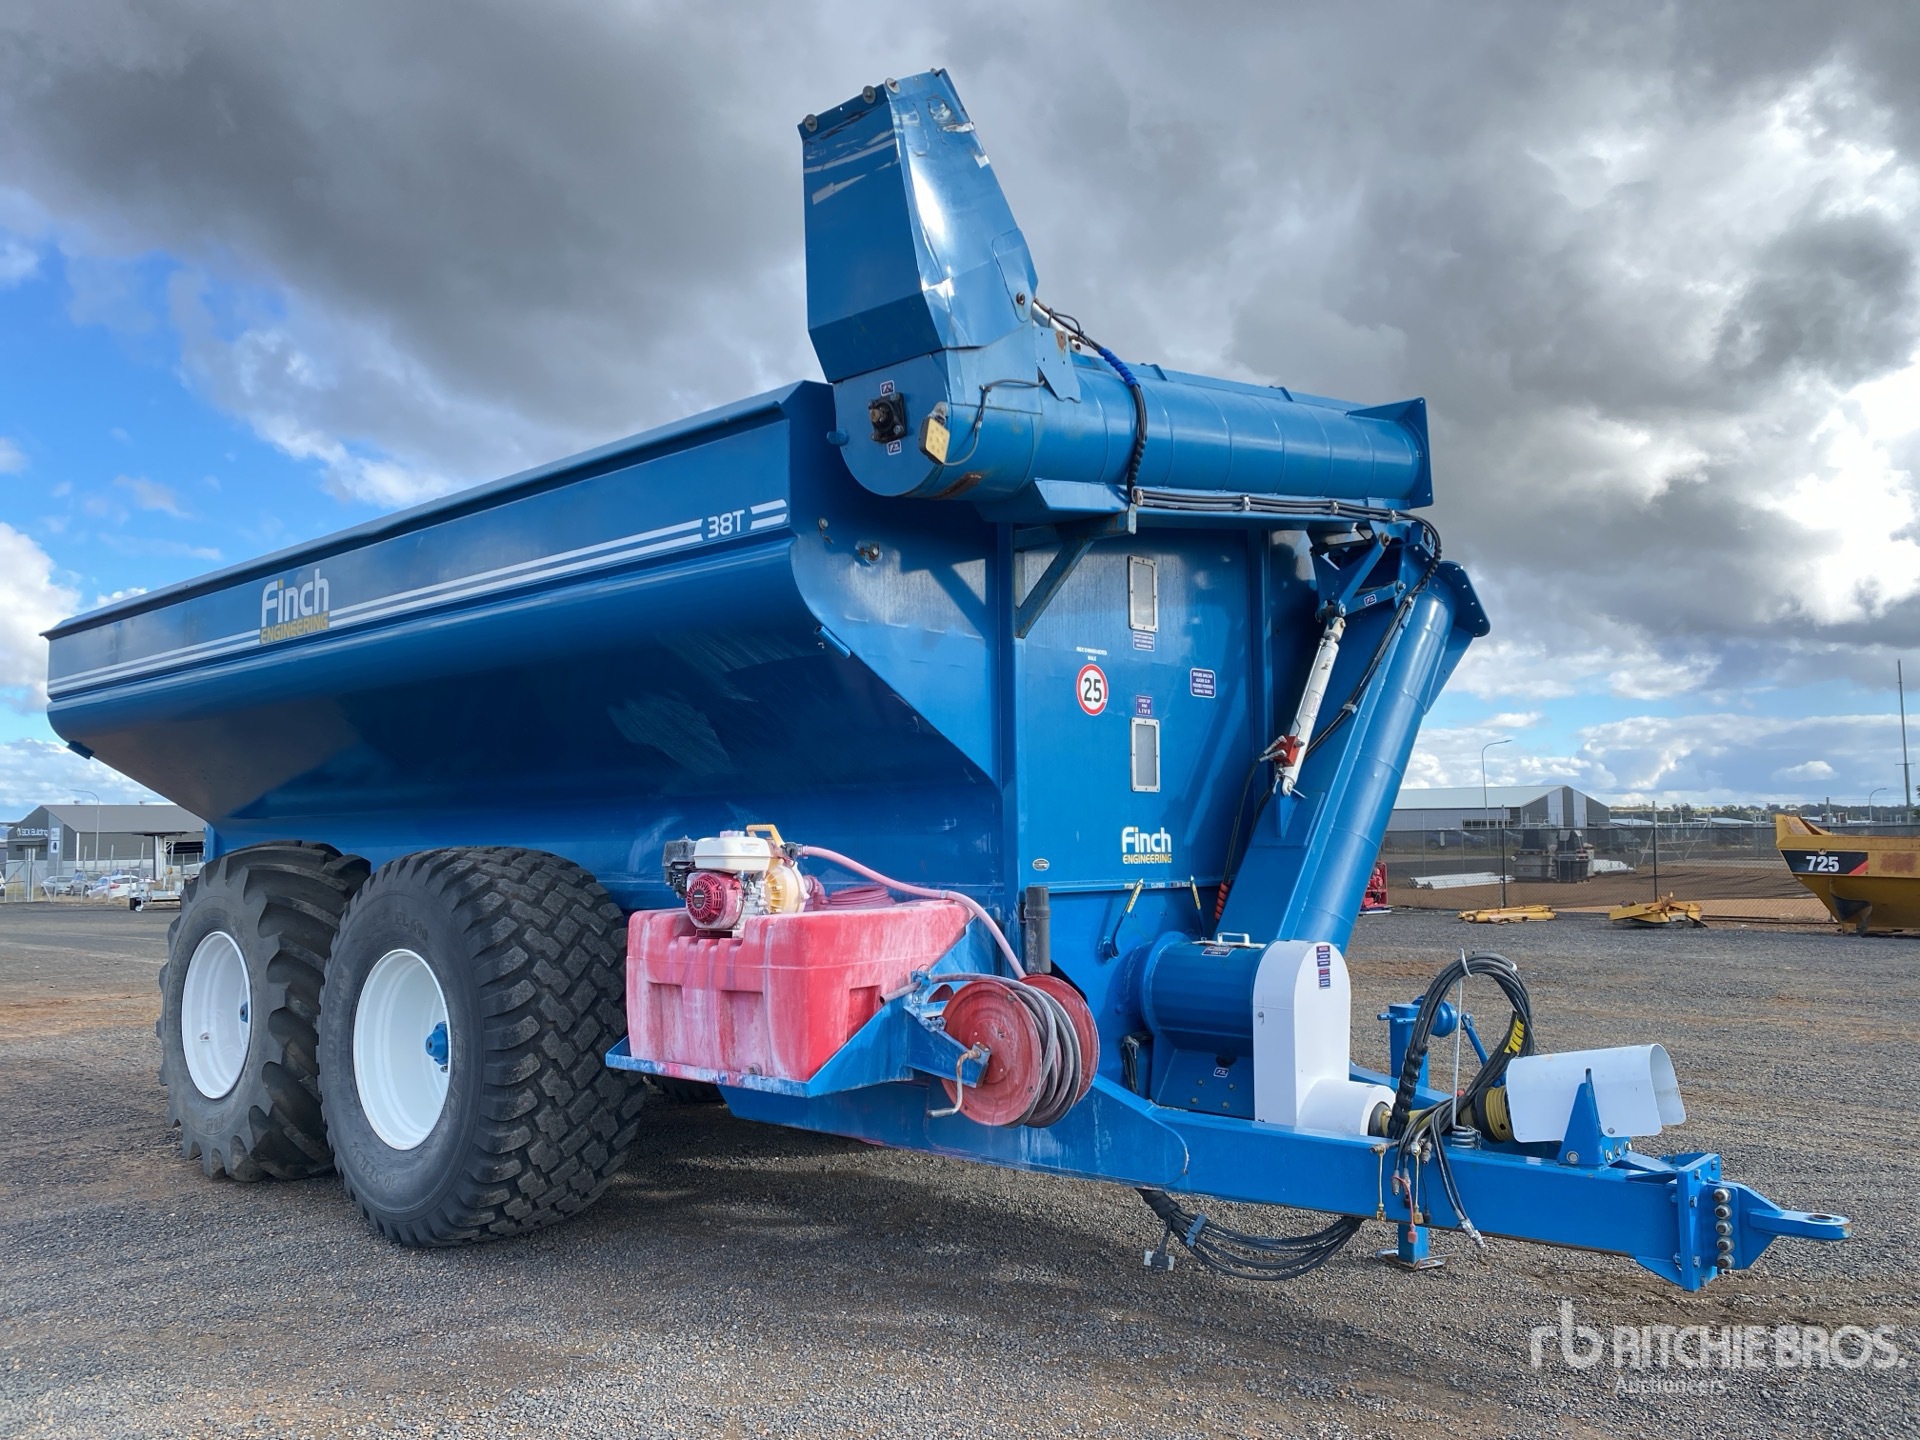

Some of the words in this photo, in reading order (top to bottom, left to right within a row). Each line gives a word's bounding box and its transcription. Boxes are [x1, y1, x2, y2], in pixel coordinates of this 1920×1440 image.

[707, 510, 745, 538] 38T
[261, 568, 329, 627] Finch
[260, 611, 329, 645] ENGINEERING
[1083, 677, 1102, 703] 25
[1121, 826, 1172, 853] Finch
[1122, 854, 1172, 865] ENGINEERING
[1806, 855, 1840, 872] 725
